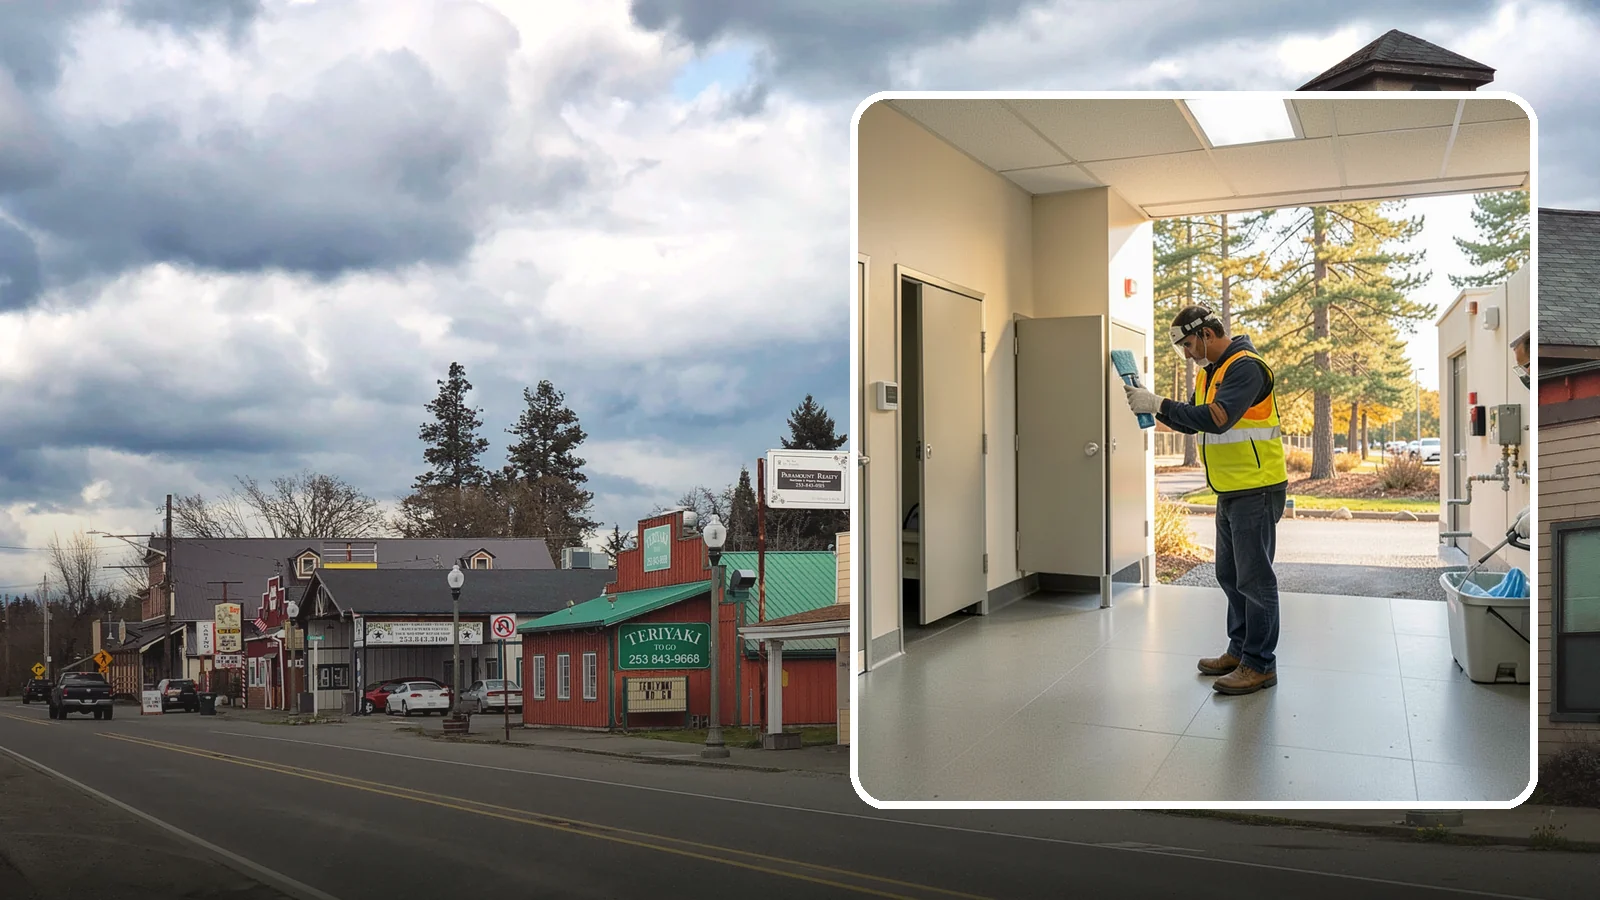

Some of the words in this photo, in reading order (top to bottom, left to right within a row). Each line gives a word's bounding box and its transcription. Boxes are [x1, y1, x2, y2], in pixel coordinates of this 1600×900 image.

[817, 472, 839, 480] REALTY
[625, 627, 702, 646] TERIYAKI
[628, 654, 648, 664] 253
[651, 654, 700, 664] 843-9668
